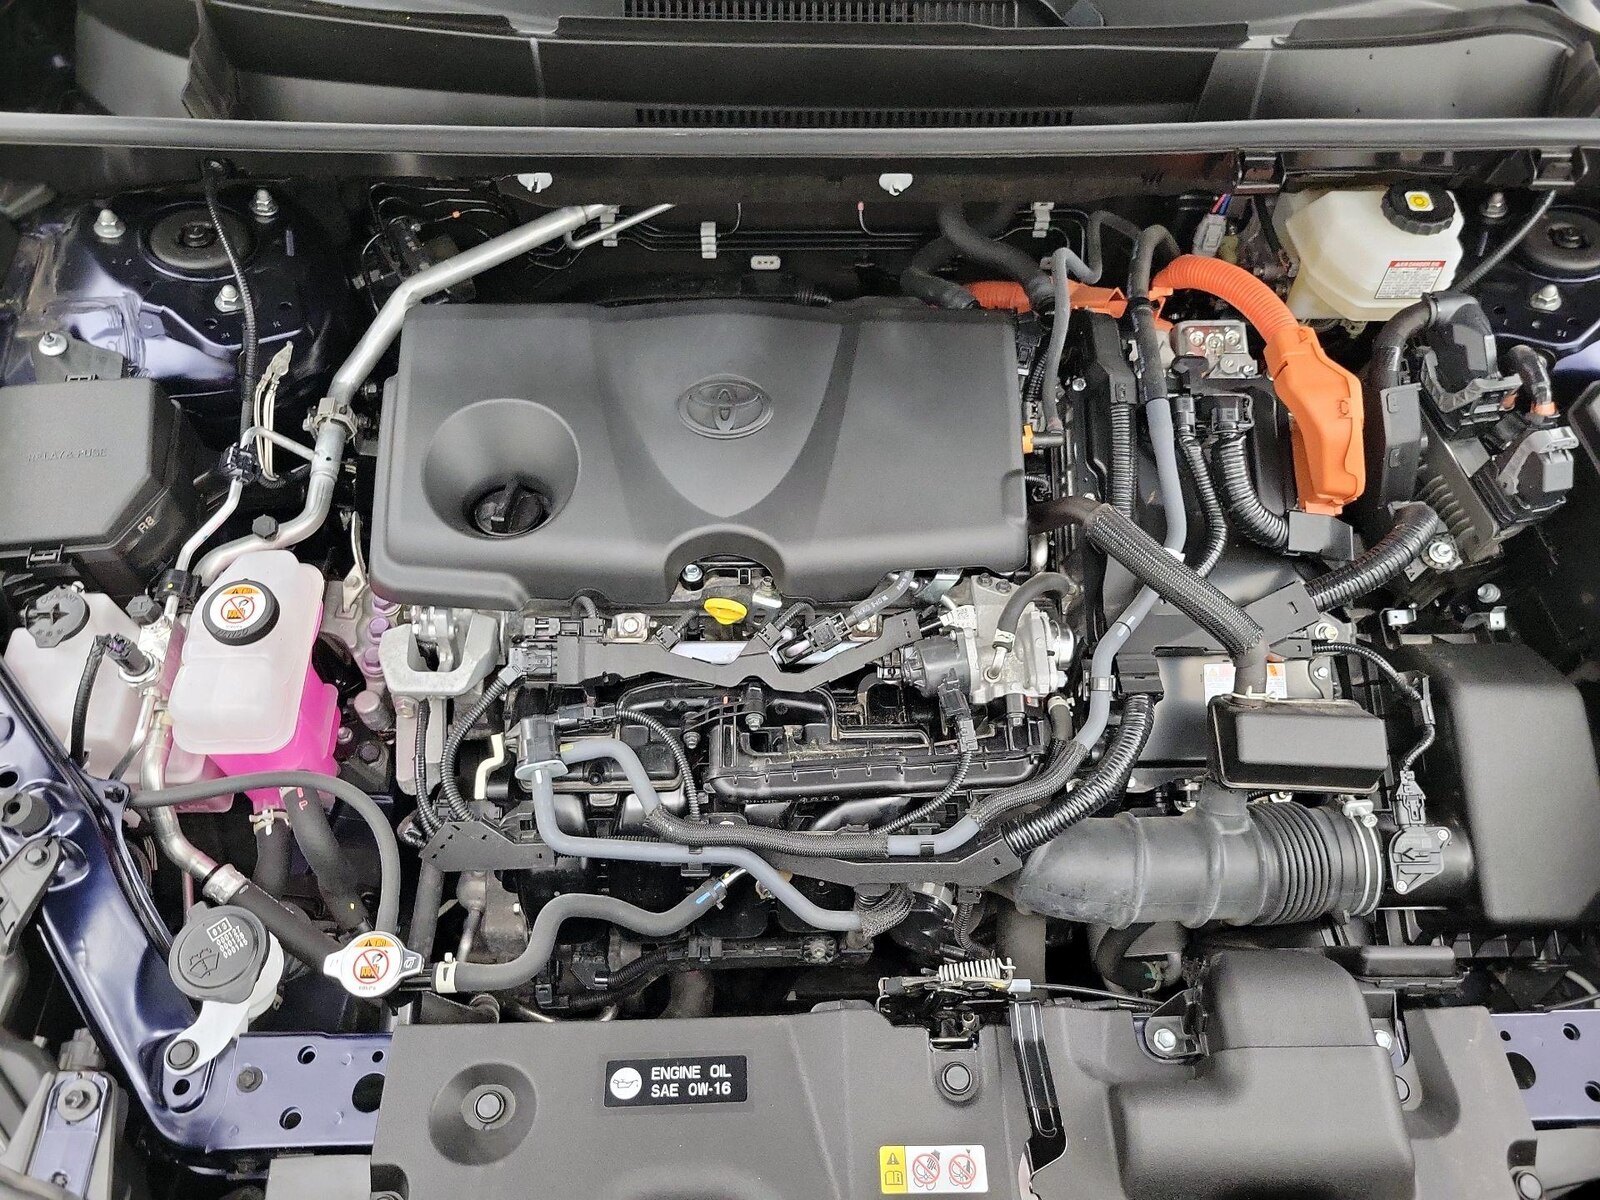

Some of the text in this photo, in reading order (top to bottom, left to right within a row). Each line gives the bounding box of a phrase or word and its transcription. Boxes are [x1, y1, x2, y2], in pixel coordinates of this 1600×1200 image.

[137, 515, 155, 534] R8
[651, 1064, 732, 1080] ENGINE OIL
[651, 1081, 731, 1098] SAE 0W-16
